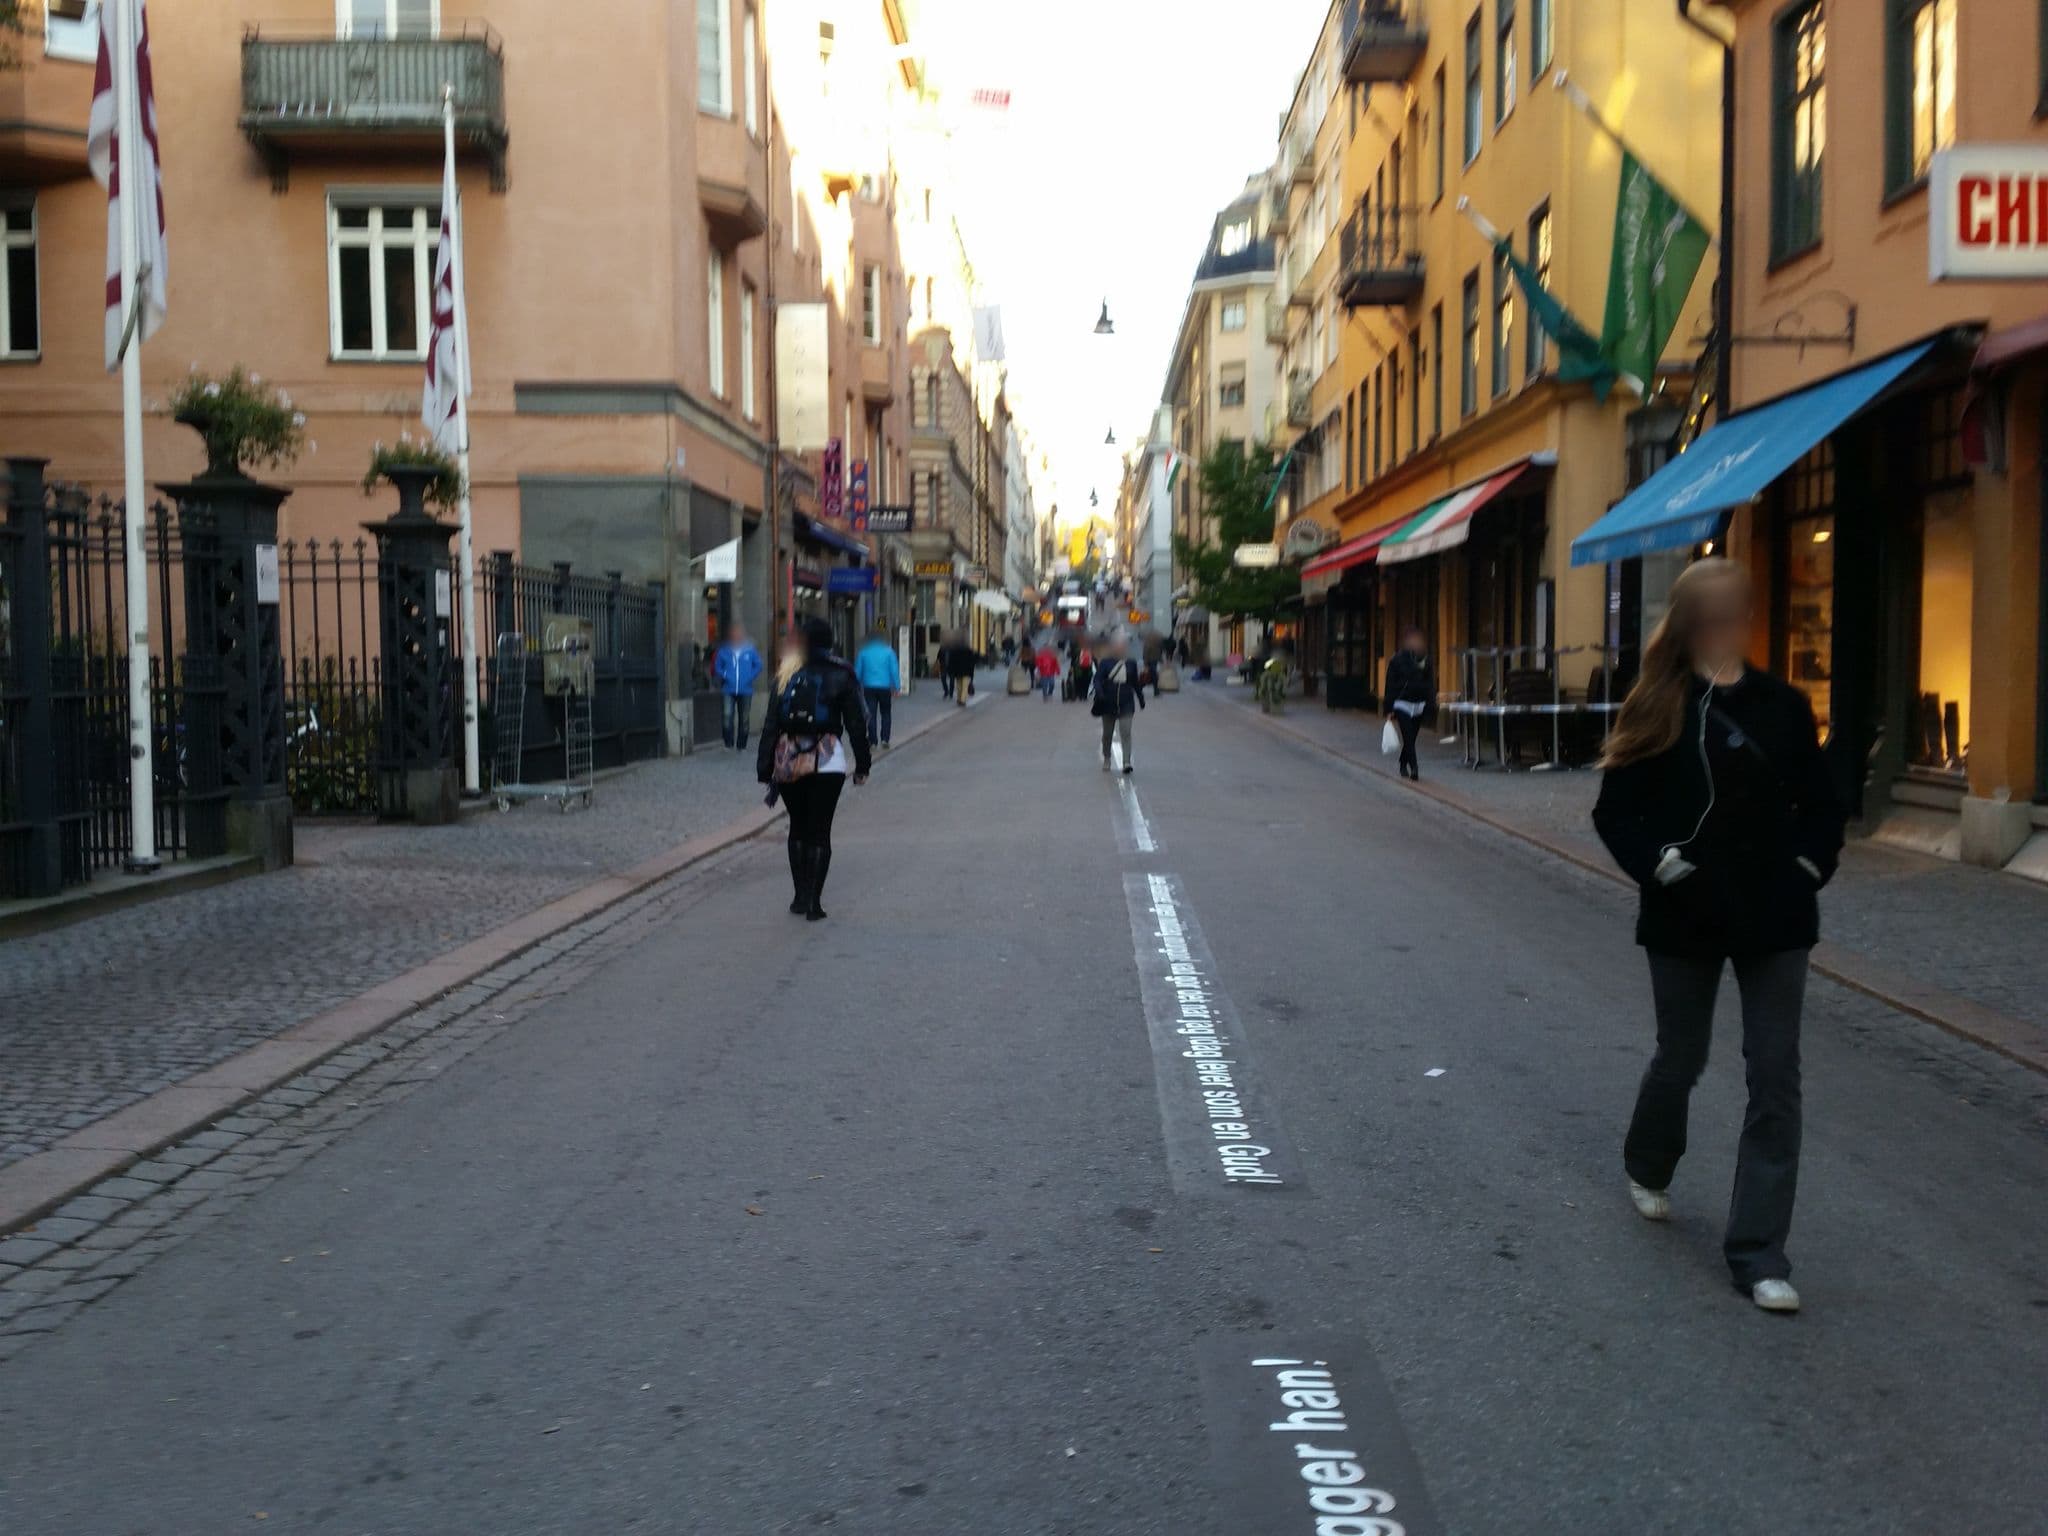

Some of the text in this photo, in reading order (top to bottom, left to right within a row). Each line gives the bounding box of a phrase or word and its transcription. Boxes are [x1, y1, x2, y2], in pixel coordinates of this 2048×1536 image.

[1177, 990, 1214, 1003] det
[1181, 1004, 1220, 1018] när
[1175, 1019, 1223, 1035] jag
[1181, 1036, 1231, 1058] idag
[1195, 1060, 1237, 1087] lever
[1202, 1090, 1245, 1119] som
[1211, 1121, 1252, 1140] en
[1217, 1144, 1284, 1184] Gud!
[1251, 1358, 1349, 1432] han!
